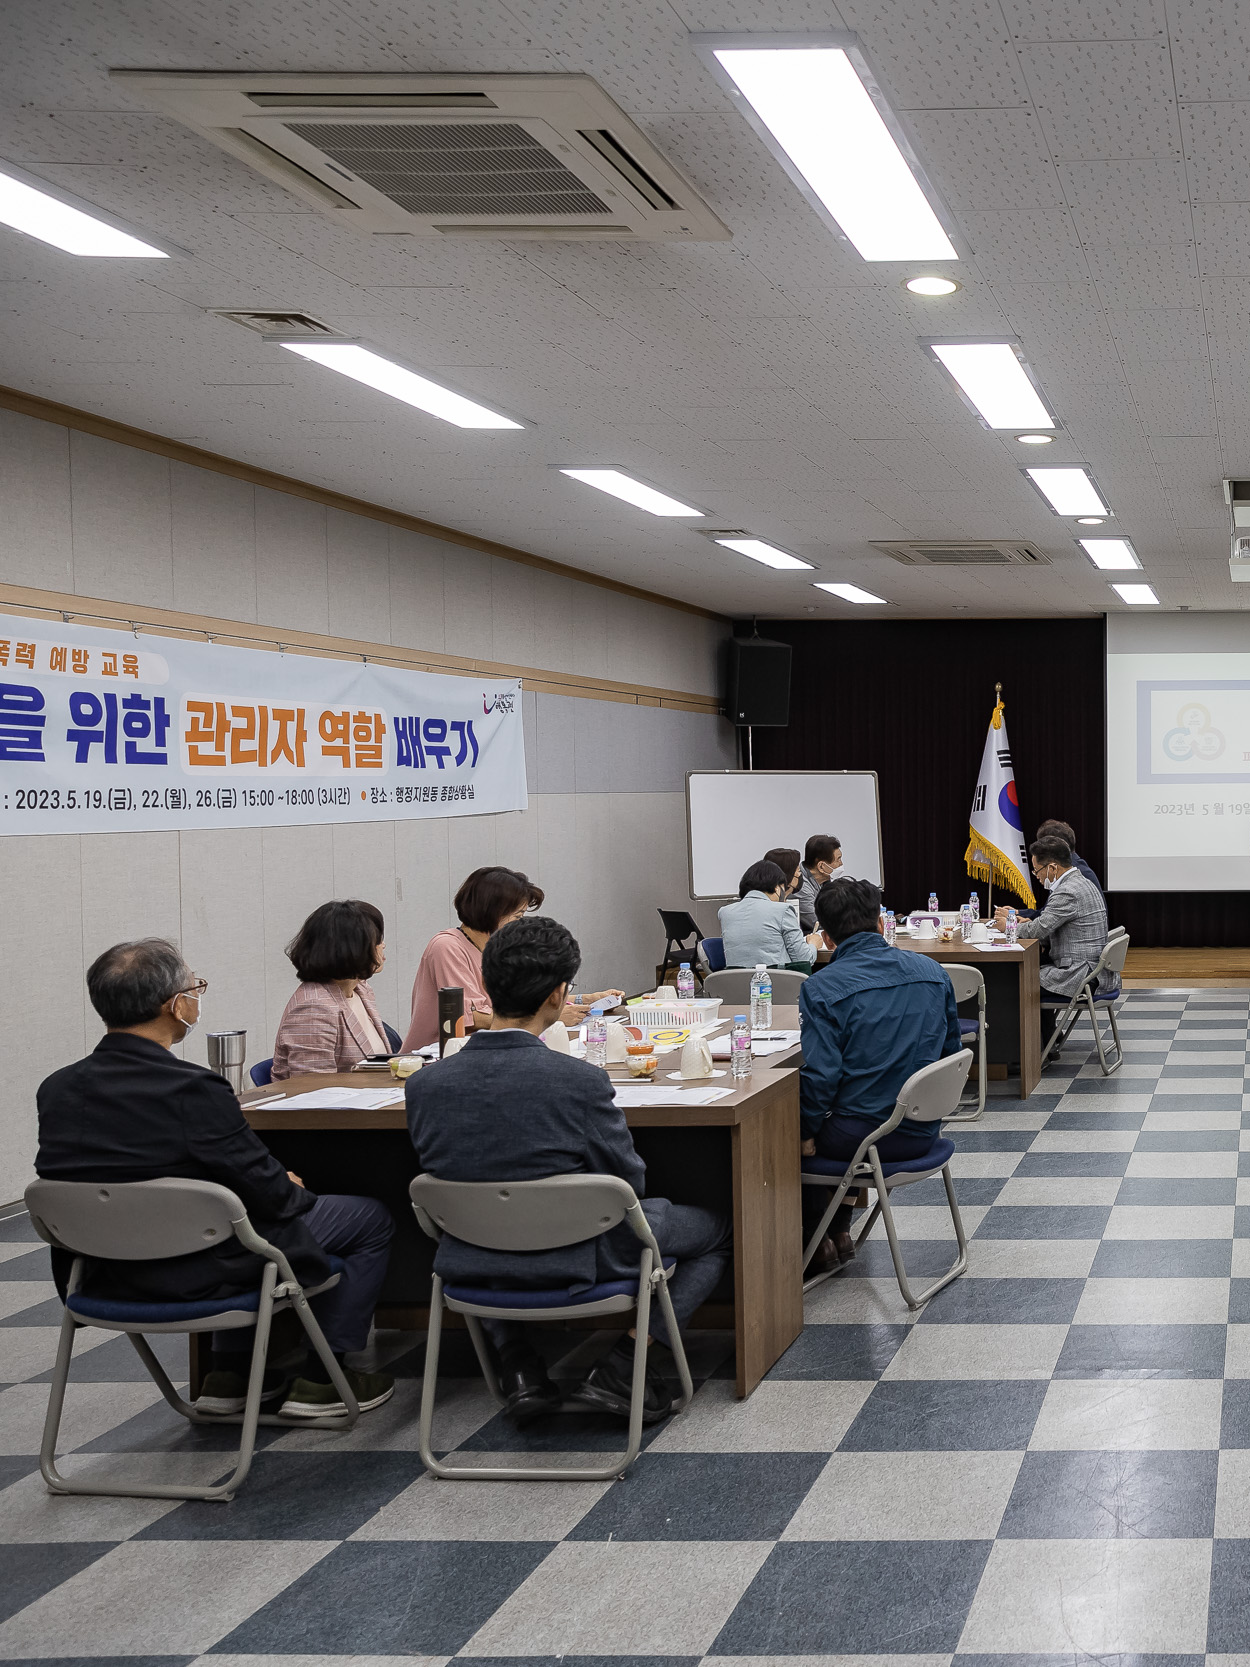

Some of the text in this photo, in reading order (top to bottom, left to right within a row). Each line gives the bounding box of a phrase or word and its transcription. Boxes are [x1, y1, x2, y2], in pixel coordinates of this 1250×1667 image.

[49, 646, 90, 675] 예방
[101, 651, 139, 679] 교육
[66, 690, 170, 765] 위한
[184, 699, 307, 768] 관리자
[318, 709, 387, 769] 역할
[393, 714, 481, 770] 배우기
[15, 787, 137, 811] 2023.5.19.(금),
[142, 788, 192, 810] 22.(월),
[196, 788, 237, 809] 26.(금)
[241, 789, 274, 807] 15:00
[317, 787, 351, 807] (3시간)
[370, 787, 388, 804] 장소
[395, 786, 439, 803] 행정지원동
[440, 784, 475, 802] 종합상황실
[1153, 802, 1195, 815] 2023년
[1202, 804, 1209, 815] 5
[1213, 802, 1225, 815] 월
